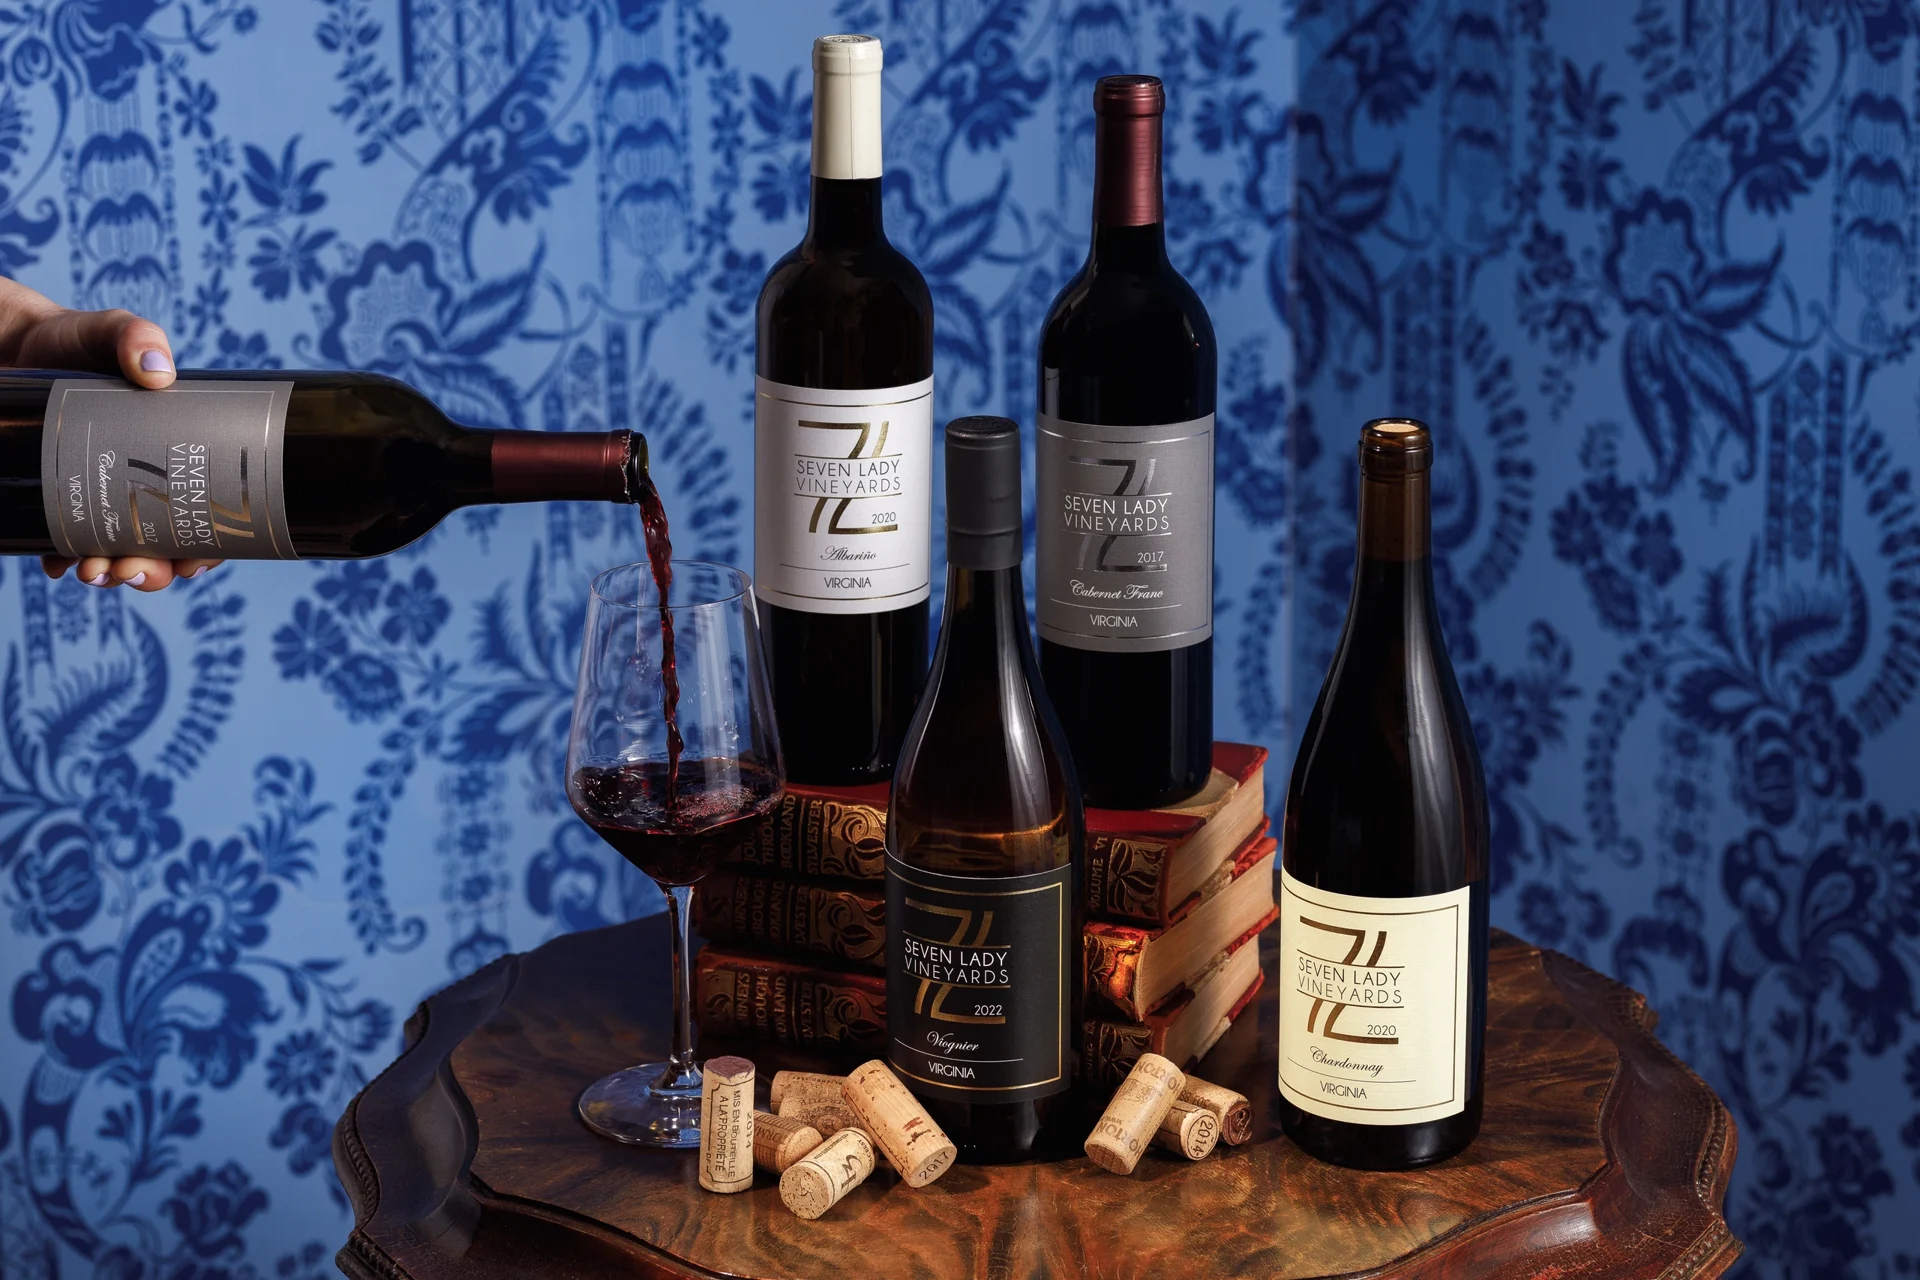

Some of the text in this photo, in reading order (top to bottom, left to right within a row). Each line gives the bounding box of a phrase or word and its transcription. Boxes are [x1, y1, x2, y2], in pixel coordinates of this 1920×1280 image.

[98, 450, 116, 509] Cabernet
[796, 458, 900, 477] SEVEN LADY
[170, 442, 196, 548] VINEYARDS
[189, 443, 215, 546] SEVEN LADY
[796, 476, 901, 494] VINEYARDS
[69, 474, 85, 523] VIRGINIA
[1064, 495, 1168, 515] SEVEN LADY
[871, 512, 896, 525] 2020
[1063, 512, 1170, 532] VINEYARDS
[142, 522, 158, 543] 2017
[820, 545, 876, 561] Albariño
[1137, 551, 1164, 564] 2017
[824, 577, 872, 589] VIRGINIA
[1069, 579, 1164, 600] Cabernet Franc
[1089, 614, 1138, 628] VIRGINIA
[806, 799, 823, 876] SYLVESTER
[905, 938, 1008, 967] SEVEN LADY
[904, 954, 1009, 985] VINEYARDS
[1298, 956, 1401, 987] SEVEN LADY
[1298, 973, 1402, 1004] VINEYARDS
[974, 1004, 1003, 1016] 2022
[926, 1030, 979, 1054] Viognier
[1367, 1024, 1397, 1036] 2020
[928, 1061, 975, 1079] VIRGINIA
[1309, 1045, 1384, 1078] Chardonnay
[1134, 1061, 1182, 1094] HORTON
[1320, 1080, 1367, 1099] VIRGINIA
[715, 1115, 729, 1172] PROPRIÉTÉ
[727, 1089, 741, 1178] MIS EN BOUTEILLE
[1096, 1122, 1143, 1160] HORTON
[1192, 1119, 1213, 1153] 2014
[918, 1151, 950, 1181] 2017
